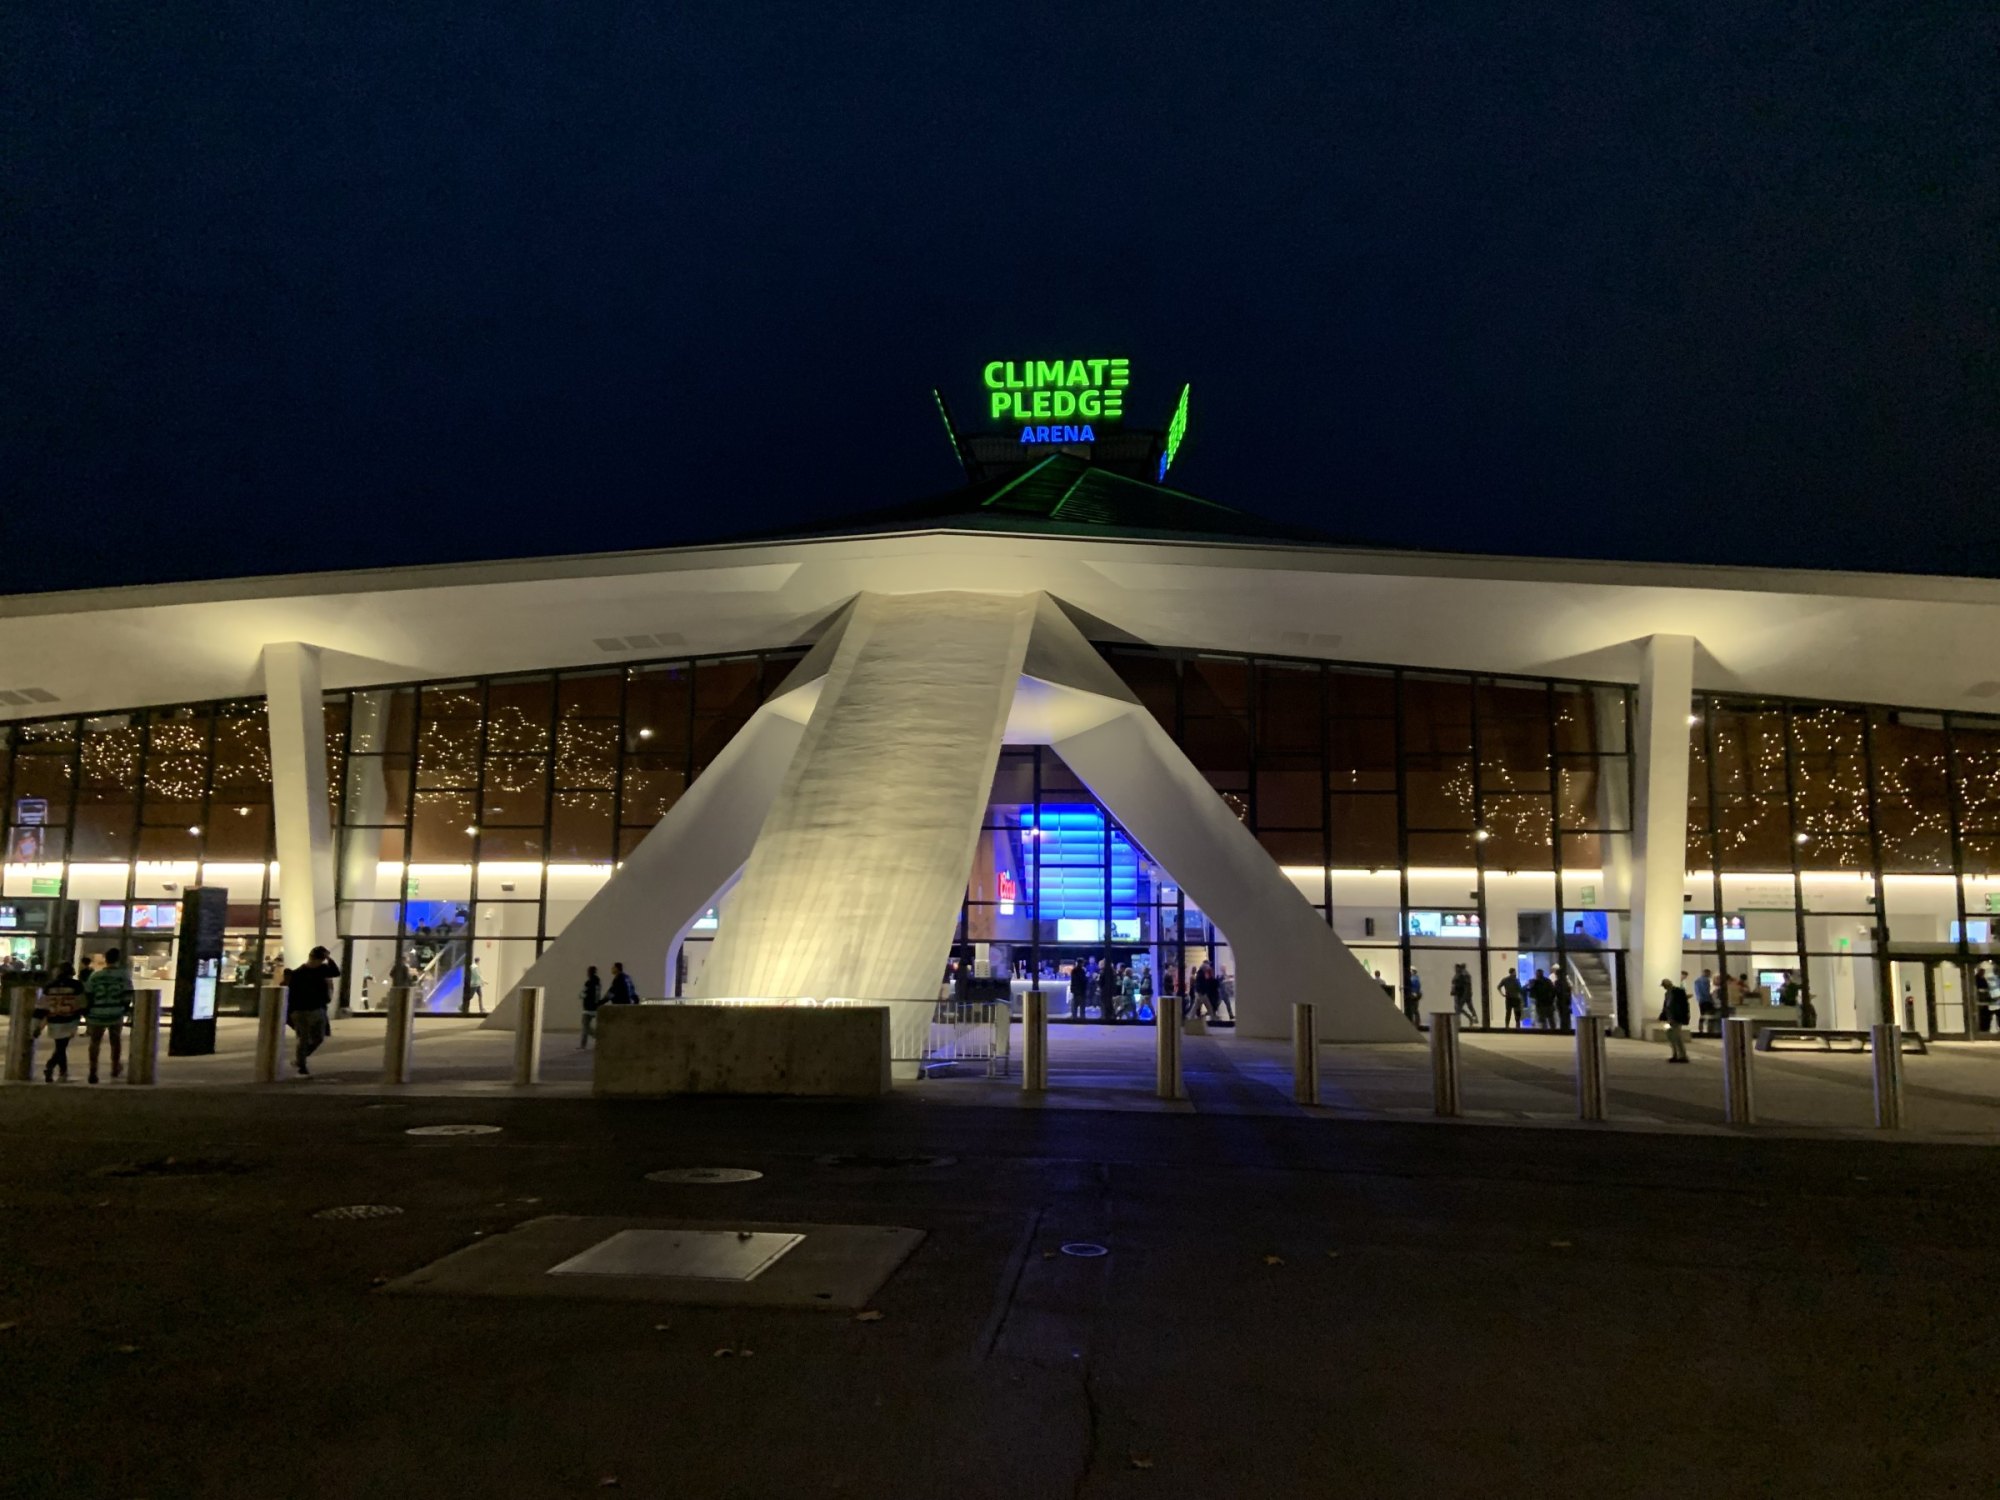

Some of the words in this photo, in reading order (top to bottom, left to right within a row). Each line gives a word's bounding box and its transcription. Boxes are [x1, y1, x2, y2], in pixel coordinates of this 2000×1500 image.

[984, 358, 1129, 388] CLIMATE
[991, 389, 1122, 418] PLEDGE
[1020, 425, 1095, 443] ARENA
